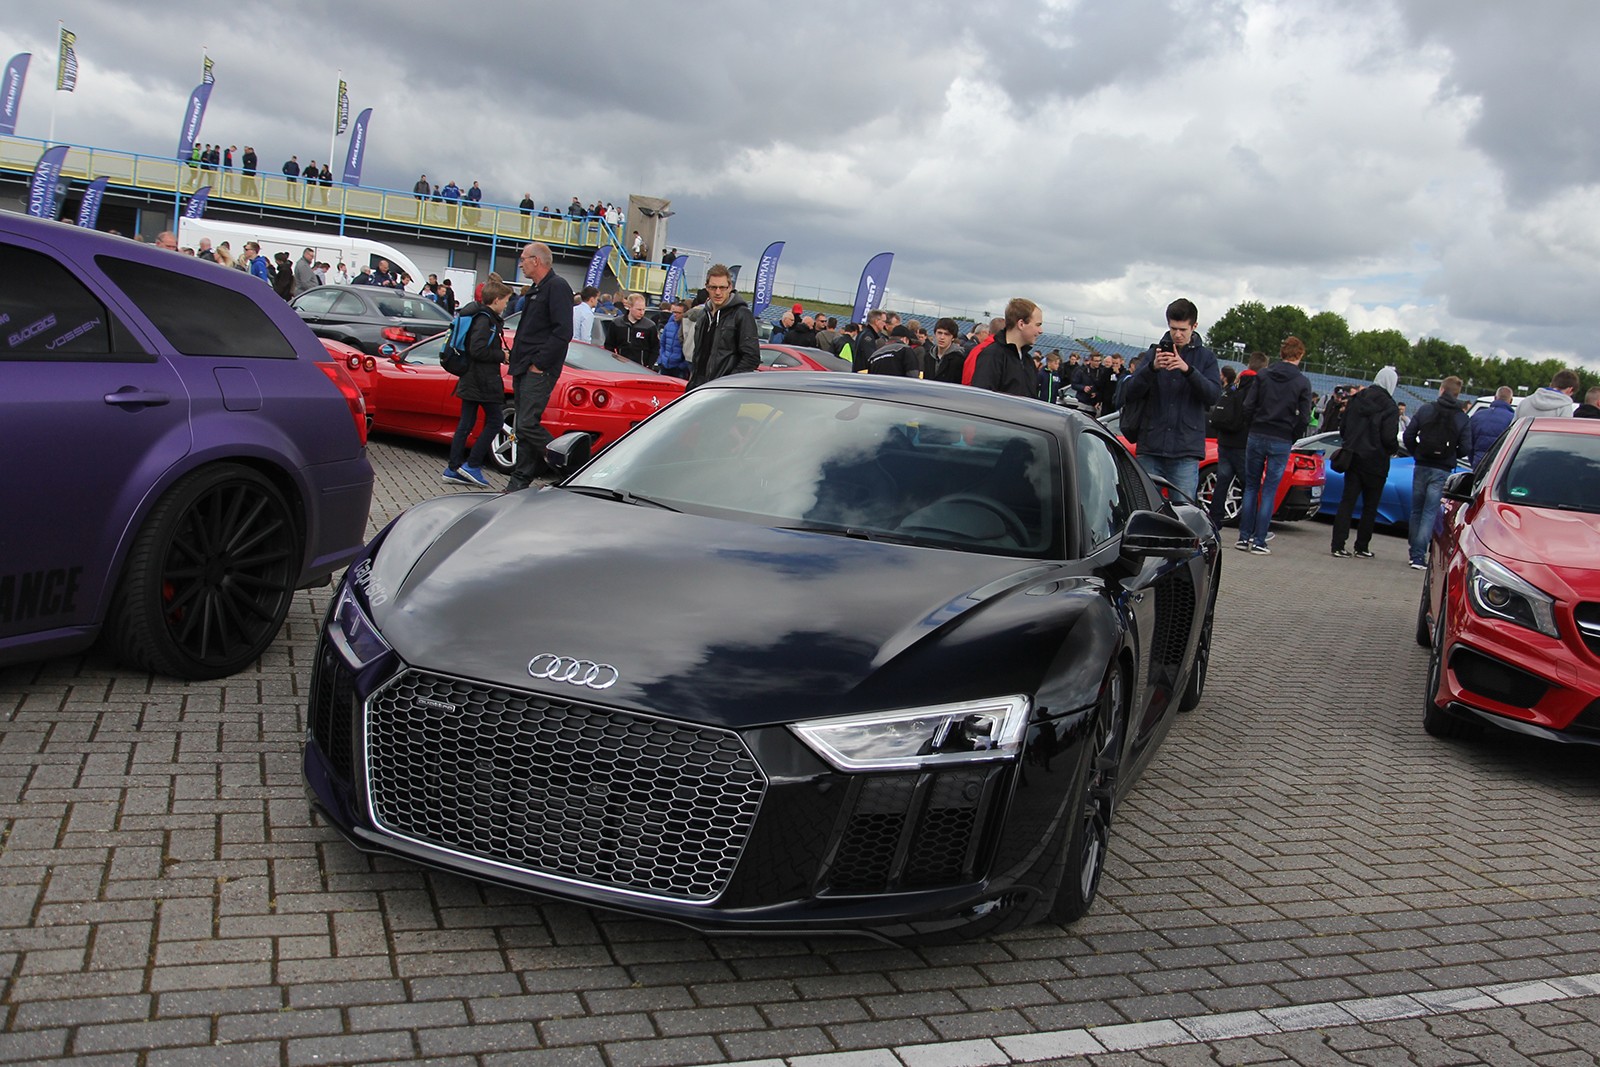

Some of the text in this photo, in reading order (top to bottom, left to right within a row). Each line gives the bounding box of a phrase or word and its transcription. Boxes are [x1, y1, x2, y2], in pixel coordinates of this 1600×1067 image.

[4, 70, 19, 116] McLaren
[187, 100, 201, 143] McLaren
[351, 126, 363, 168] McLaren
[78, 188, 97, 228] OUWMAN
[756, 255, 772, 304] LOUWMAN
[45, 317, 101, 350] VOSSEN
[353, 558, 388, 607] Capristo
[417, 699, 454, 711] quattro
